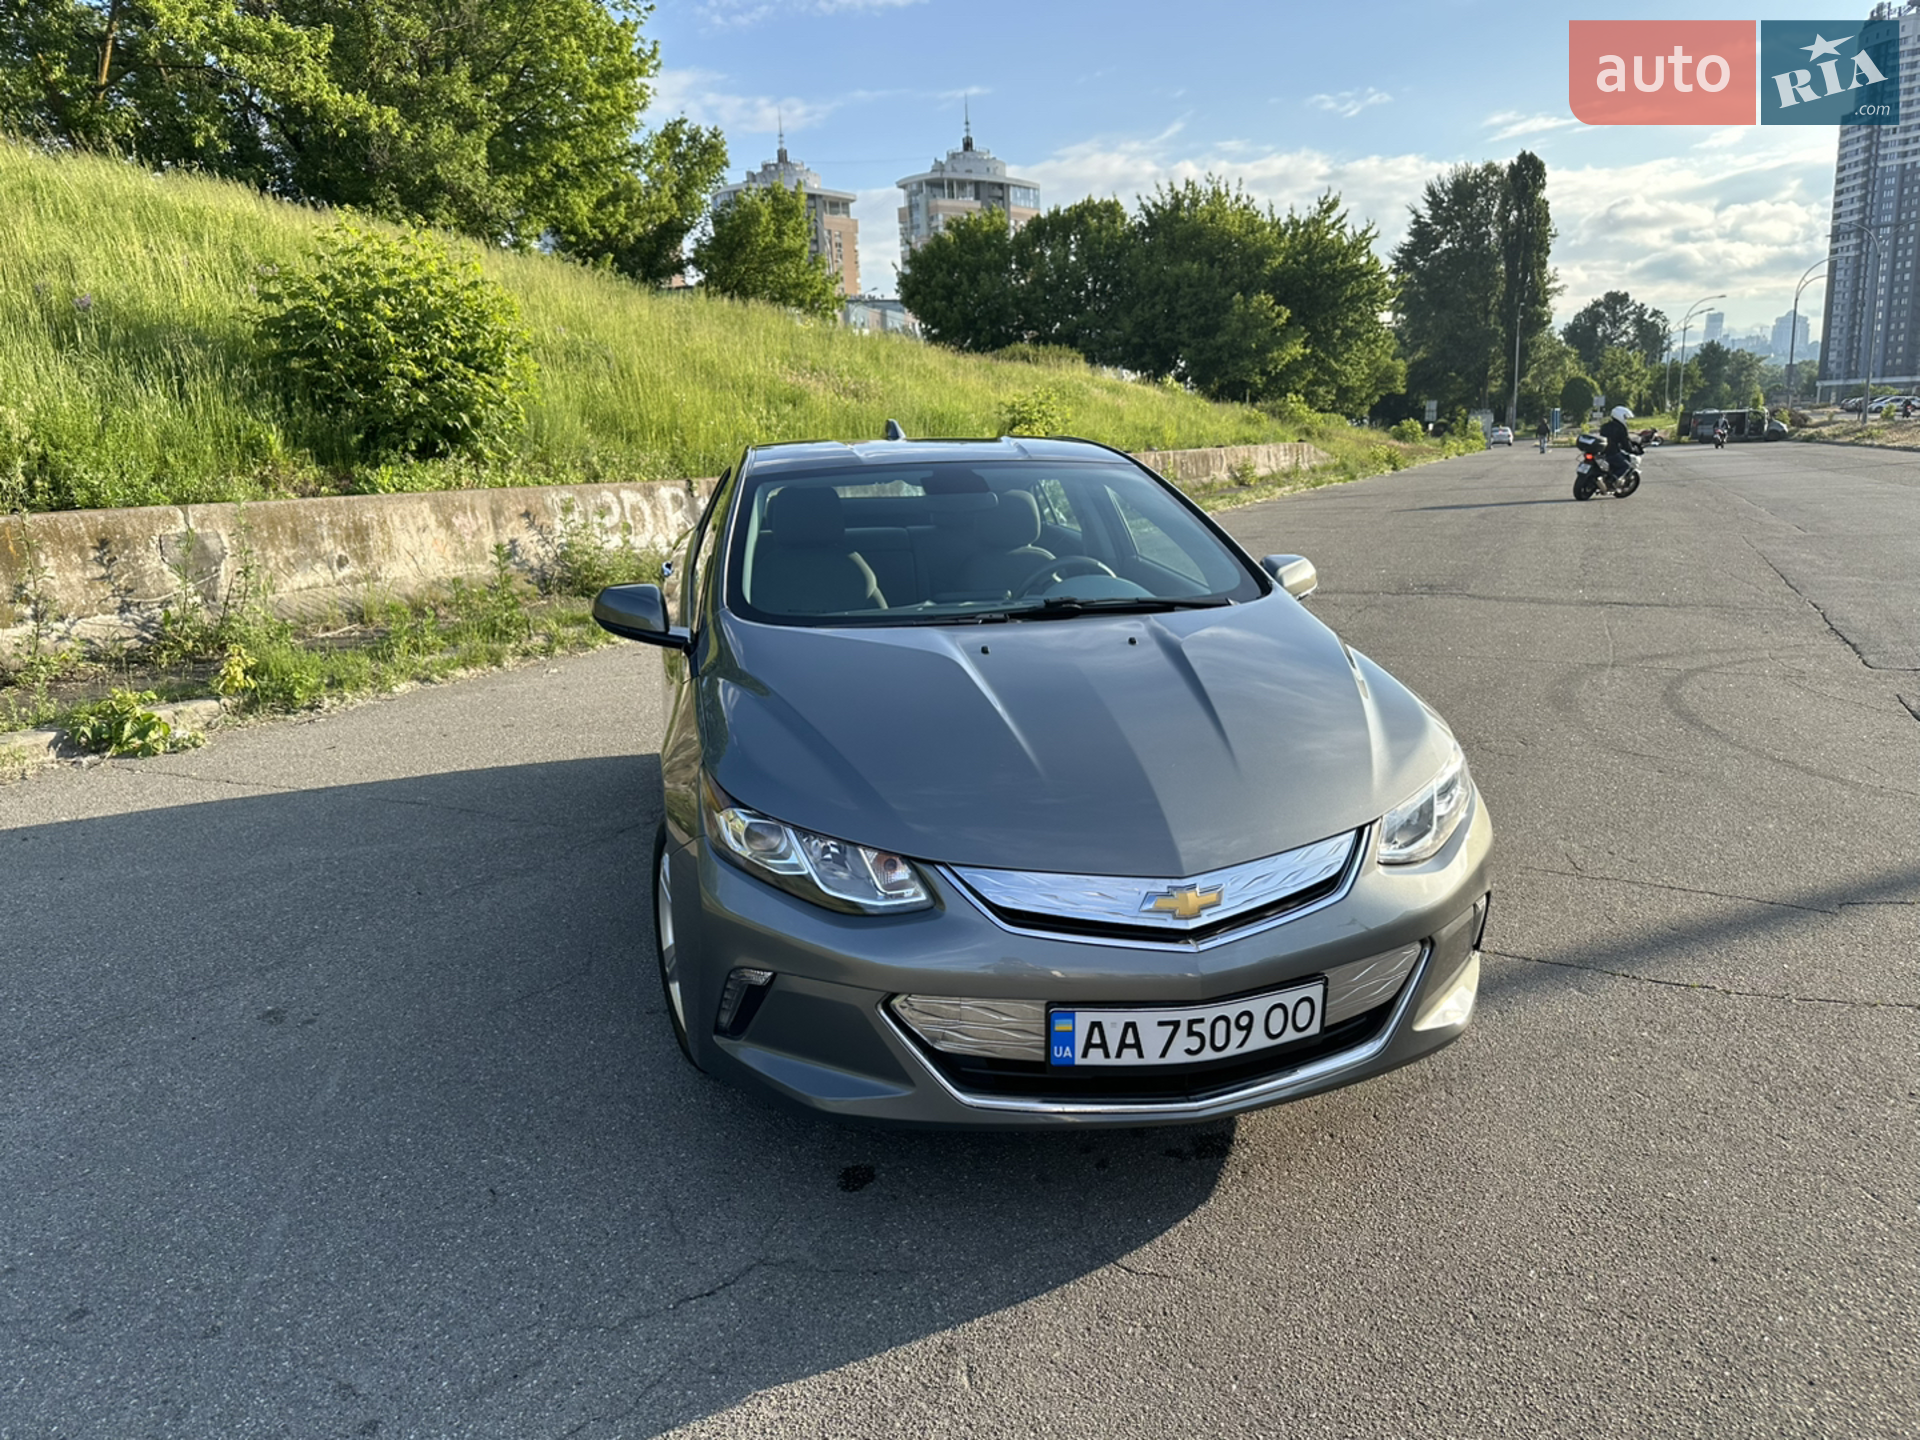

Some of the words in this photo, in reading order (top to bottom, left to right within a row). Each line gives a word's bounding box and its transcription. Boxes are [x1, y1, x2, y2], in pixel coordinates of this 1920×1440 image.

[1080, 1020, 1144, 1059] AA
[1157, 1010, 1254, 1058] 7509
[1264, 996, 1315, 1040] OO
[1054, 1046, 1073, 1058] UA
